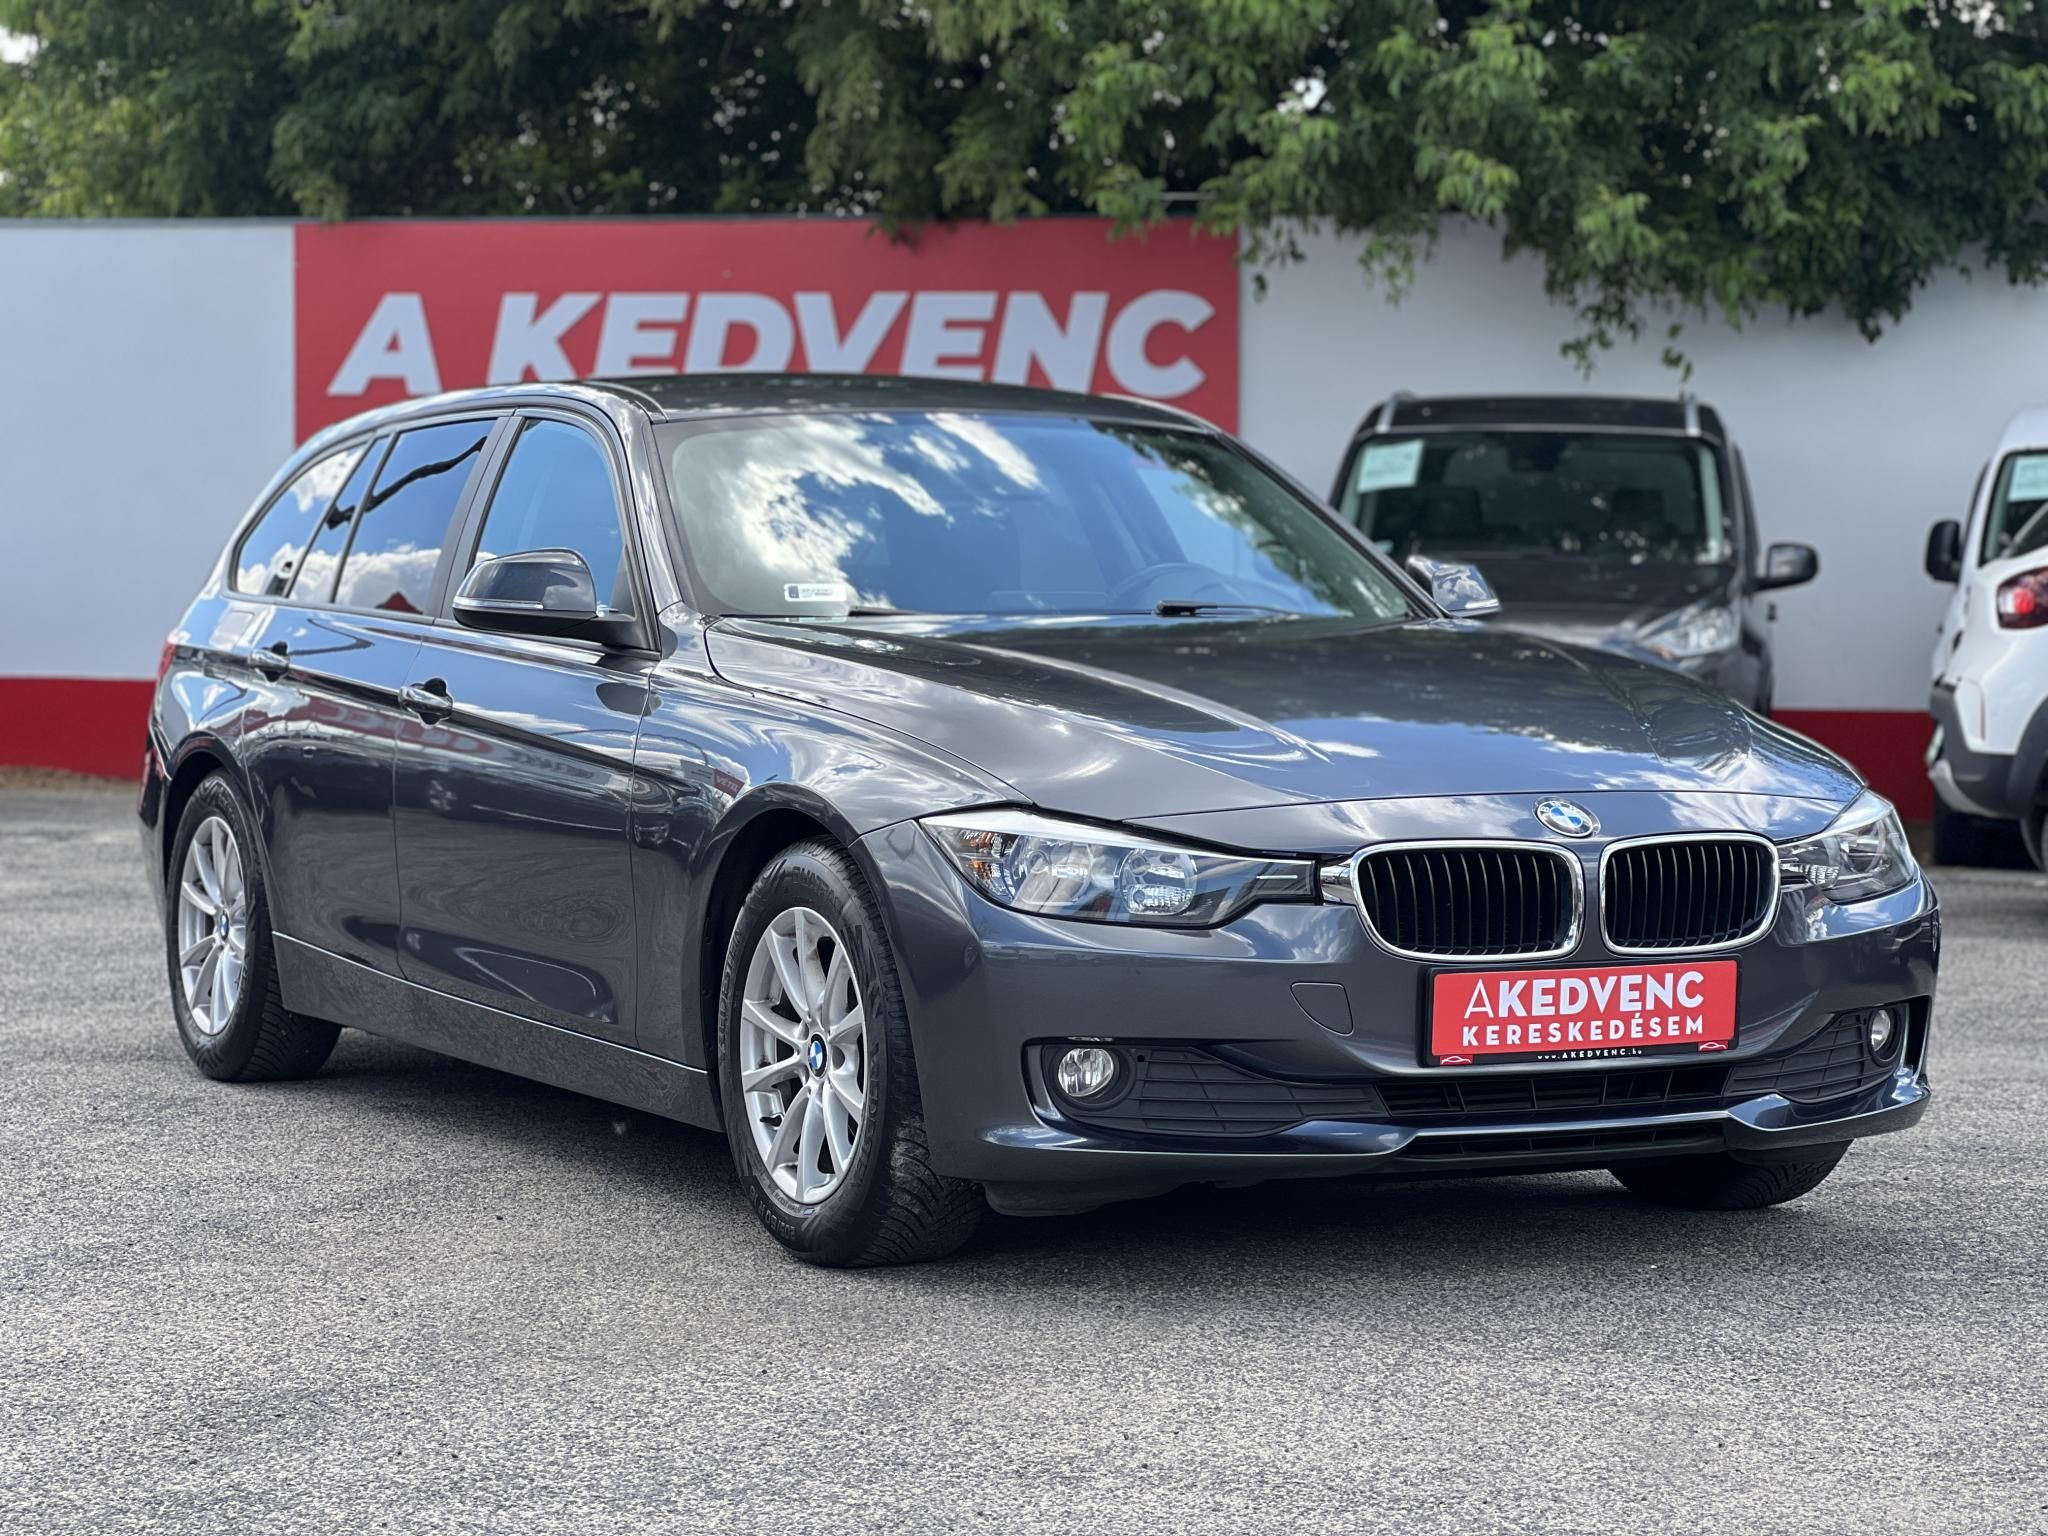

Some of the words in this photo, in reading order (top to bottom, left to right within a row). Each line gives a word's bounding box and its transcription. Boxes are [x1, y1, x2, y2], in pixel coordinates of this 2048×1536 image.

[327, 292, 443, 396] A
[487, 289, 1216, 399] KEDVENC
[1462, 1013, 1704, 1047] KERESKEDÉSEM
